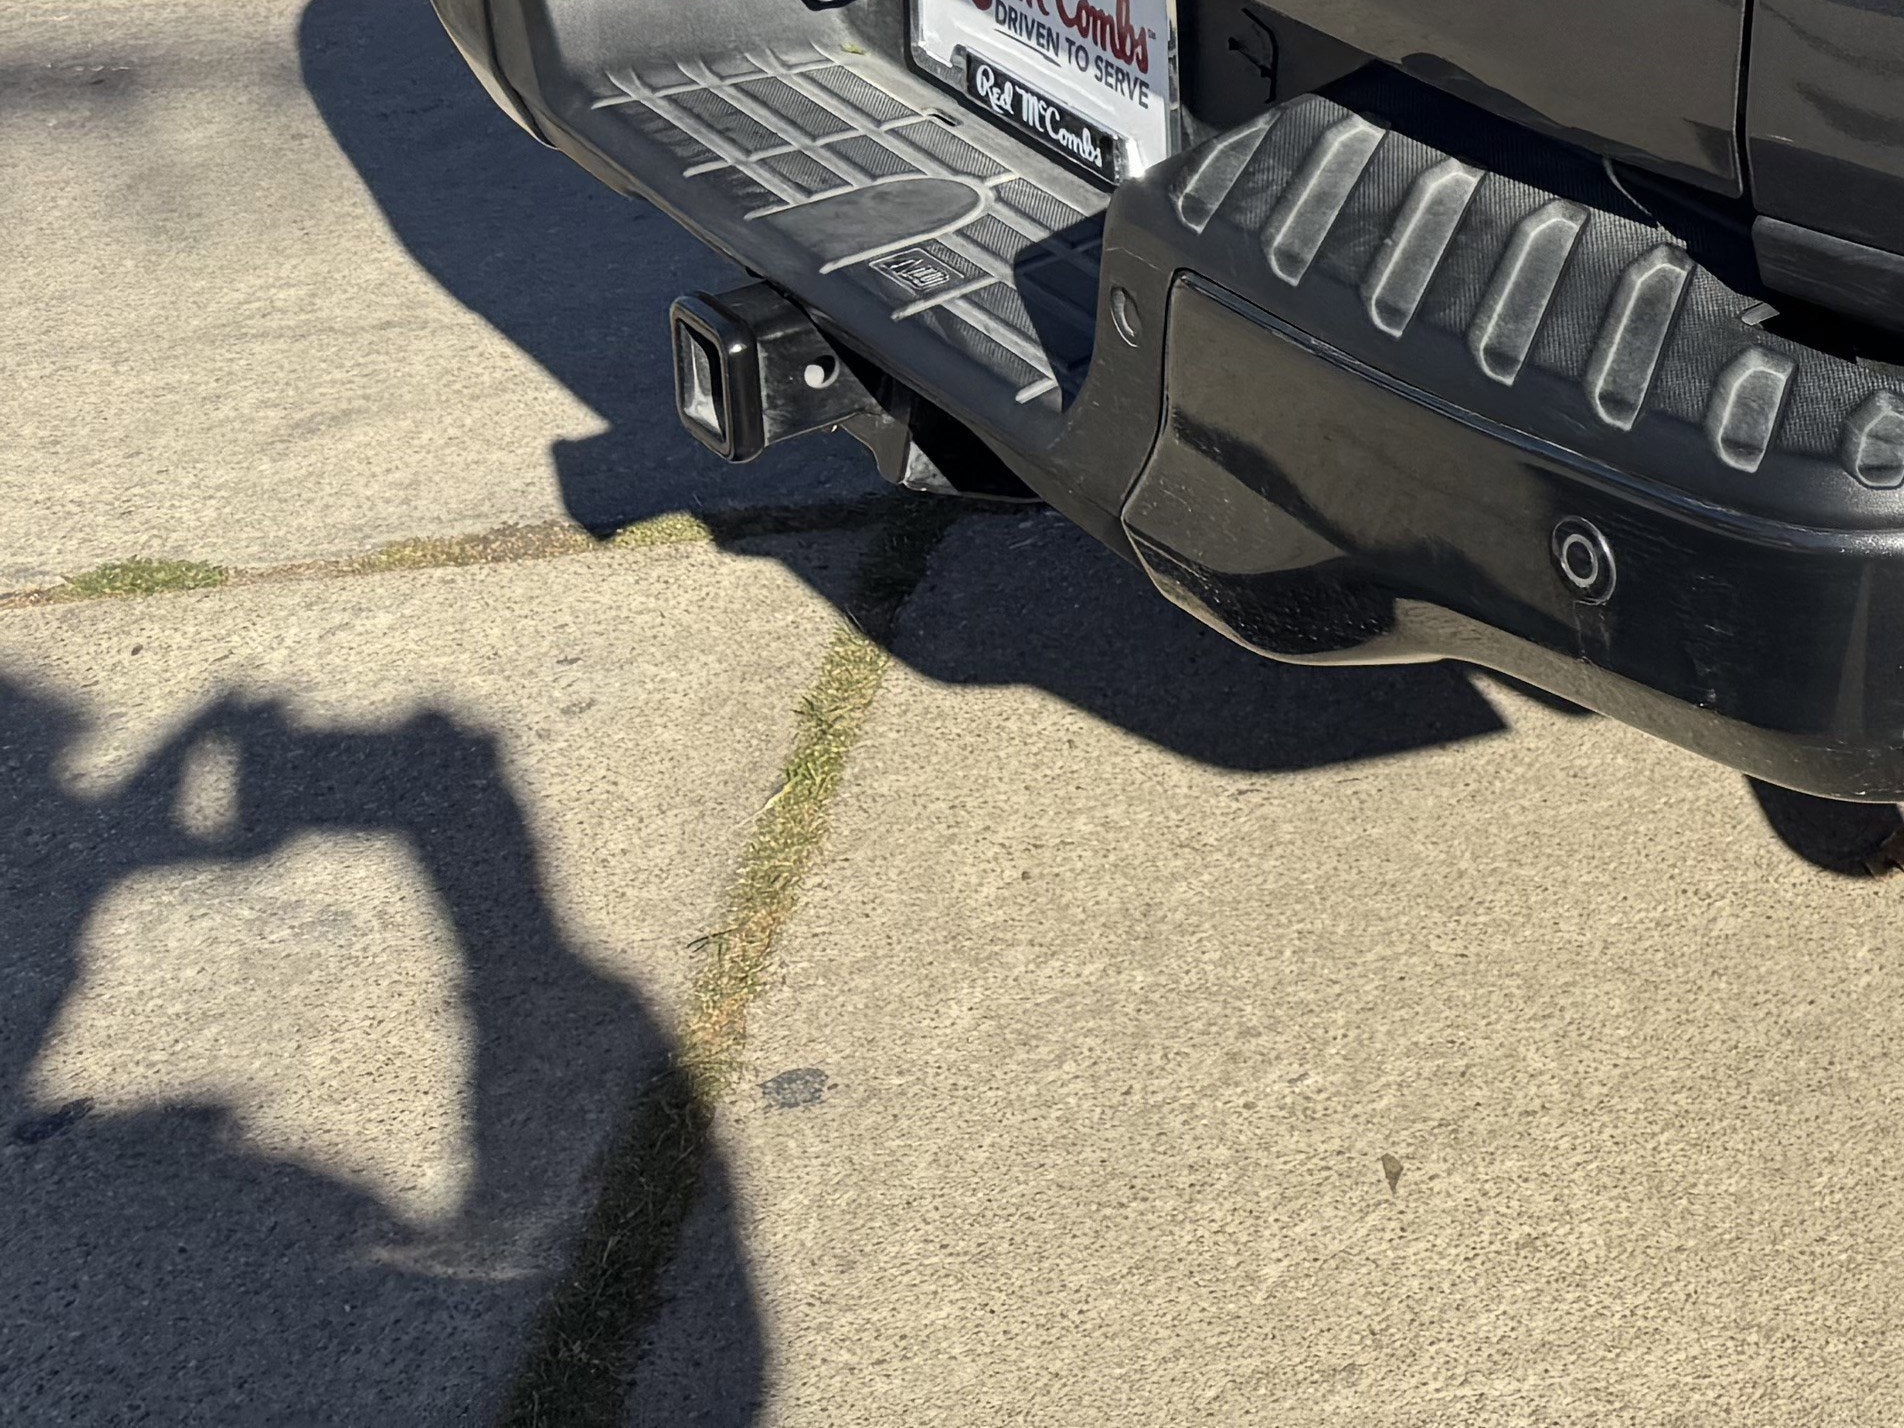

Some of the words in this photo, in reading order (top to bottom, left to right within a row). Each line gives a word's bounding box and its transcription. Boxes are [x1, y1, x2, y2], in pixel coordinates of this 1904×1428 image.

[975, 63, 1014, 115] Red
[1015, 86, 1104, 168] McCombs
[1065, 36, 1090, 73] TO
[1094, 58, 1151, 110] SERVE
